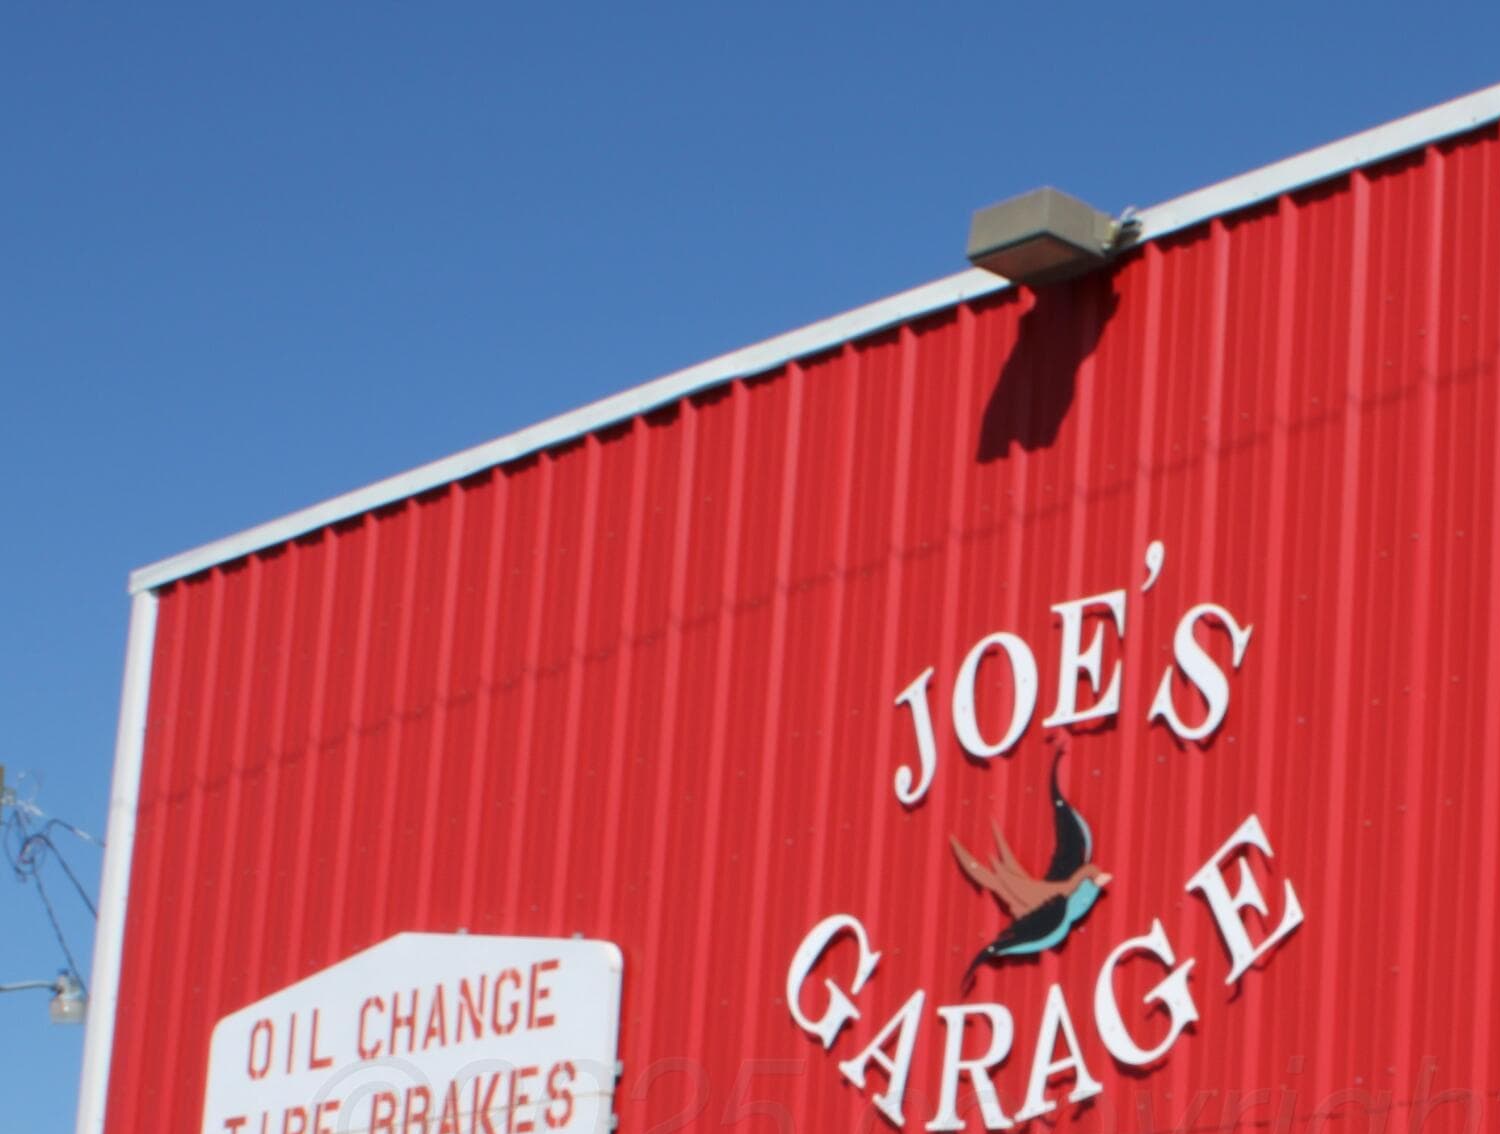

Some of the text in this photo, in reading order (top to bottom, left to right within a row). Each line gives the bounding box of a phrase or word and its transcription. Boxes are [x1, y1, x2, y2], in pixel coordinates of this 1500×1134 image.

[894, 540, 1253, 805] JOE'S
[247, 960, 559, 1081] OIL CHANGE
[786, 813, 1304, 1131] GARAGE
